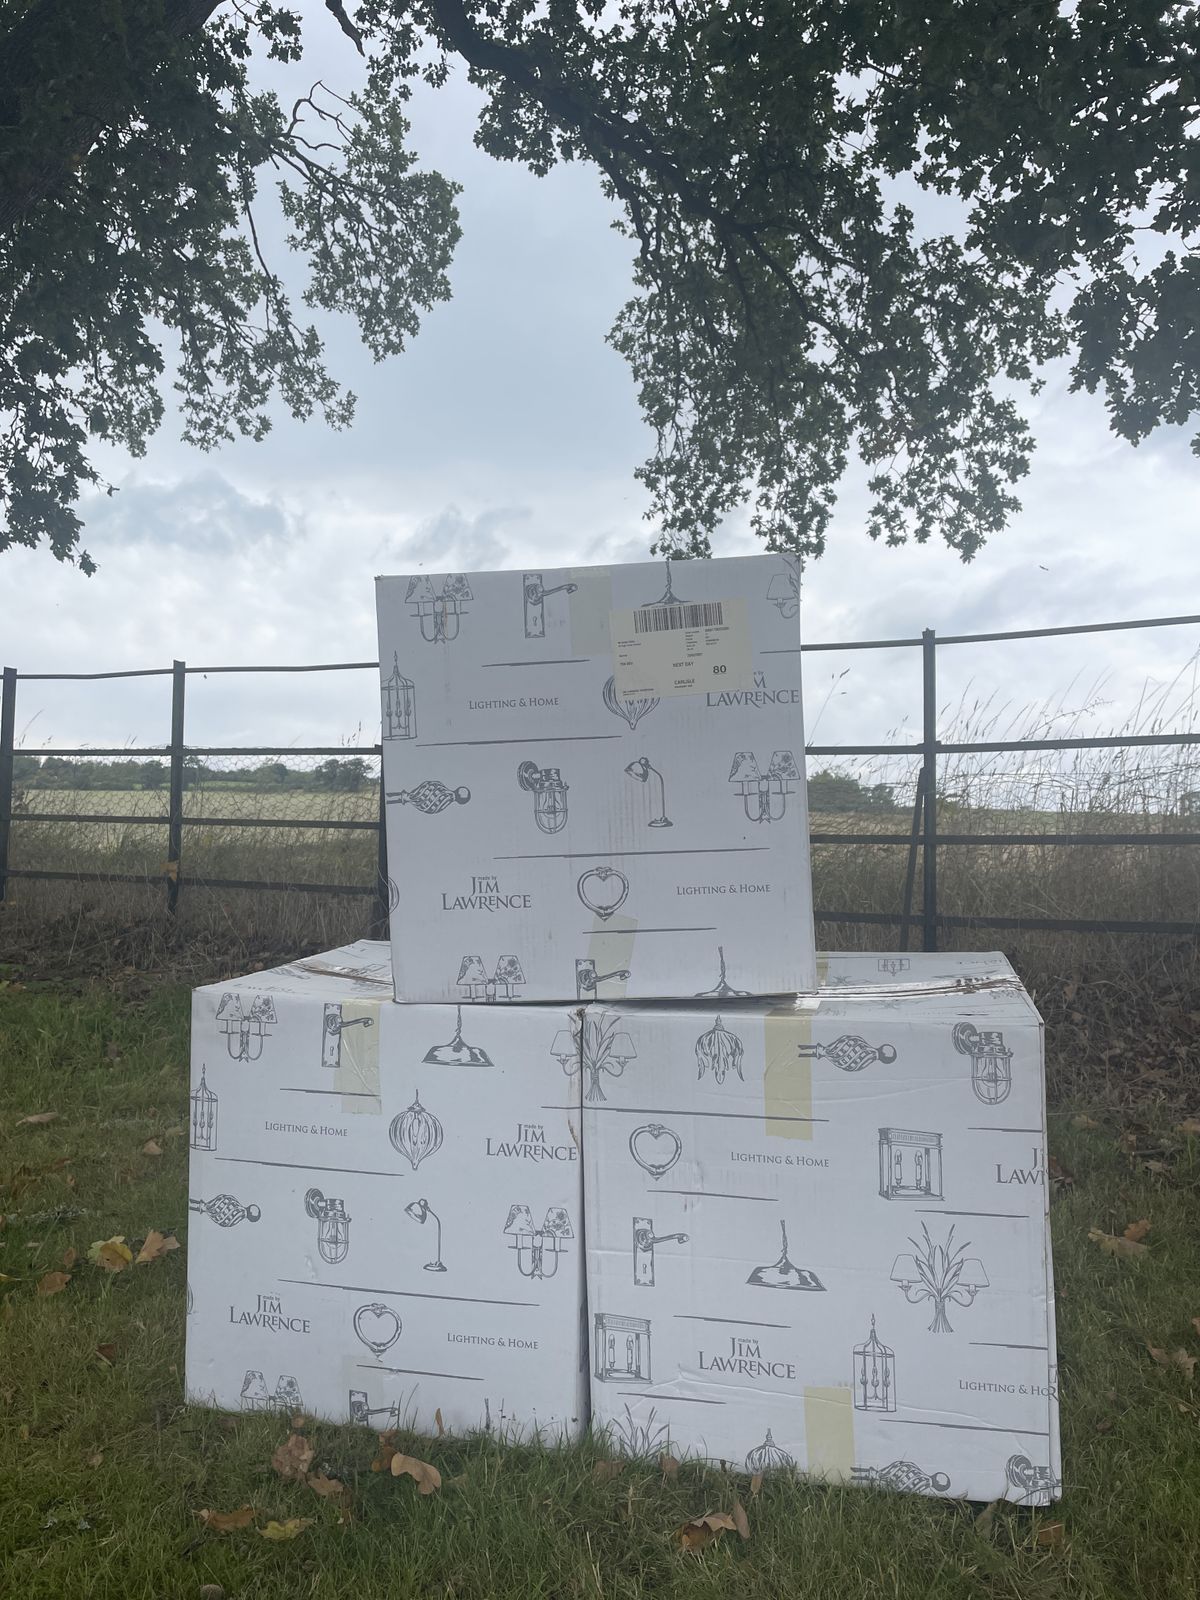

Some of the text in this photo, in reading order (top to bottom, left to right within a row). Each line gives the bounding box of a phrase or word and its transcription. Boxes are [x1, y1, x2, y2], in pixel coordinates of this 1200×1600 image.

[713, 664, 727, 674] 80
[469, 697, 559, 710] LIGHTING & HOME
[706, 689, 800, 709] LAWRENCE
[471, 876, 500, 896] JIM
[676, 883, 771, 896] LIGHTING & HOME
[441, 893, 532, 913] LAWRENCE
[265, 1121, 348, 1137] LIGHTING & HOME
[516, 1123, 546, 1144] JIM
[486, 1138, 577, 1163] LAWRENCE
[731, 1151, 829, 1168] LIGHTING & HOME
[256, 1294, 283, 1314] JIM
[229, 1305, 311, 1333] LAWRENCE
[447, 1332, 539, 1350] LIGHTING & HOME
[730, 1336, 762, 1358] JIM
[698, 1350, 796, 1379] LAWRENCE
[959, 1379, 1020, 1394] LIGHTING
[1023, 1384, 1033, 1395] &
